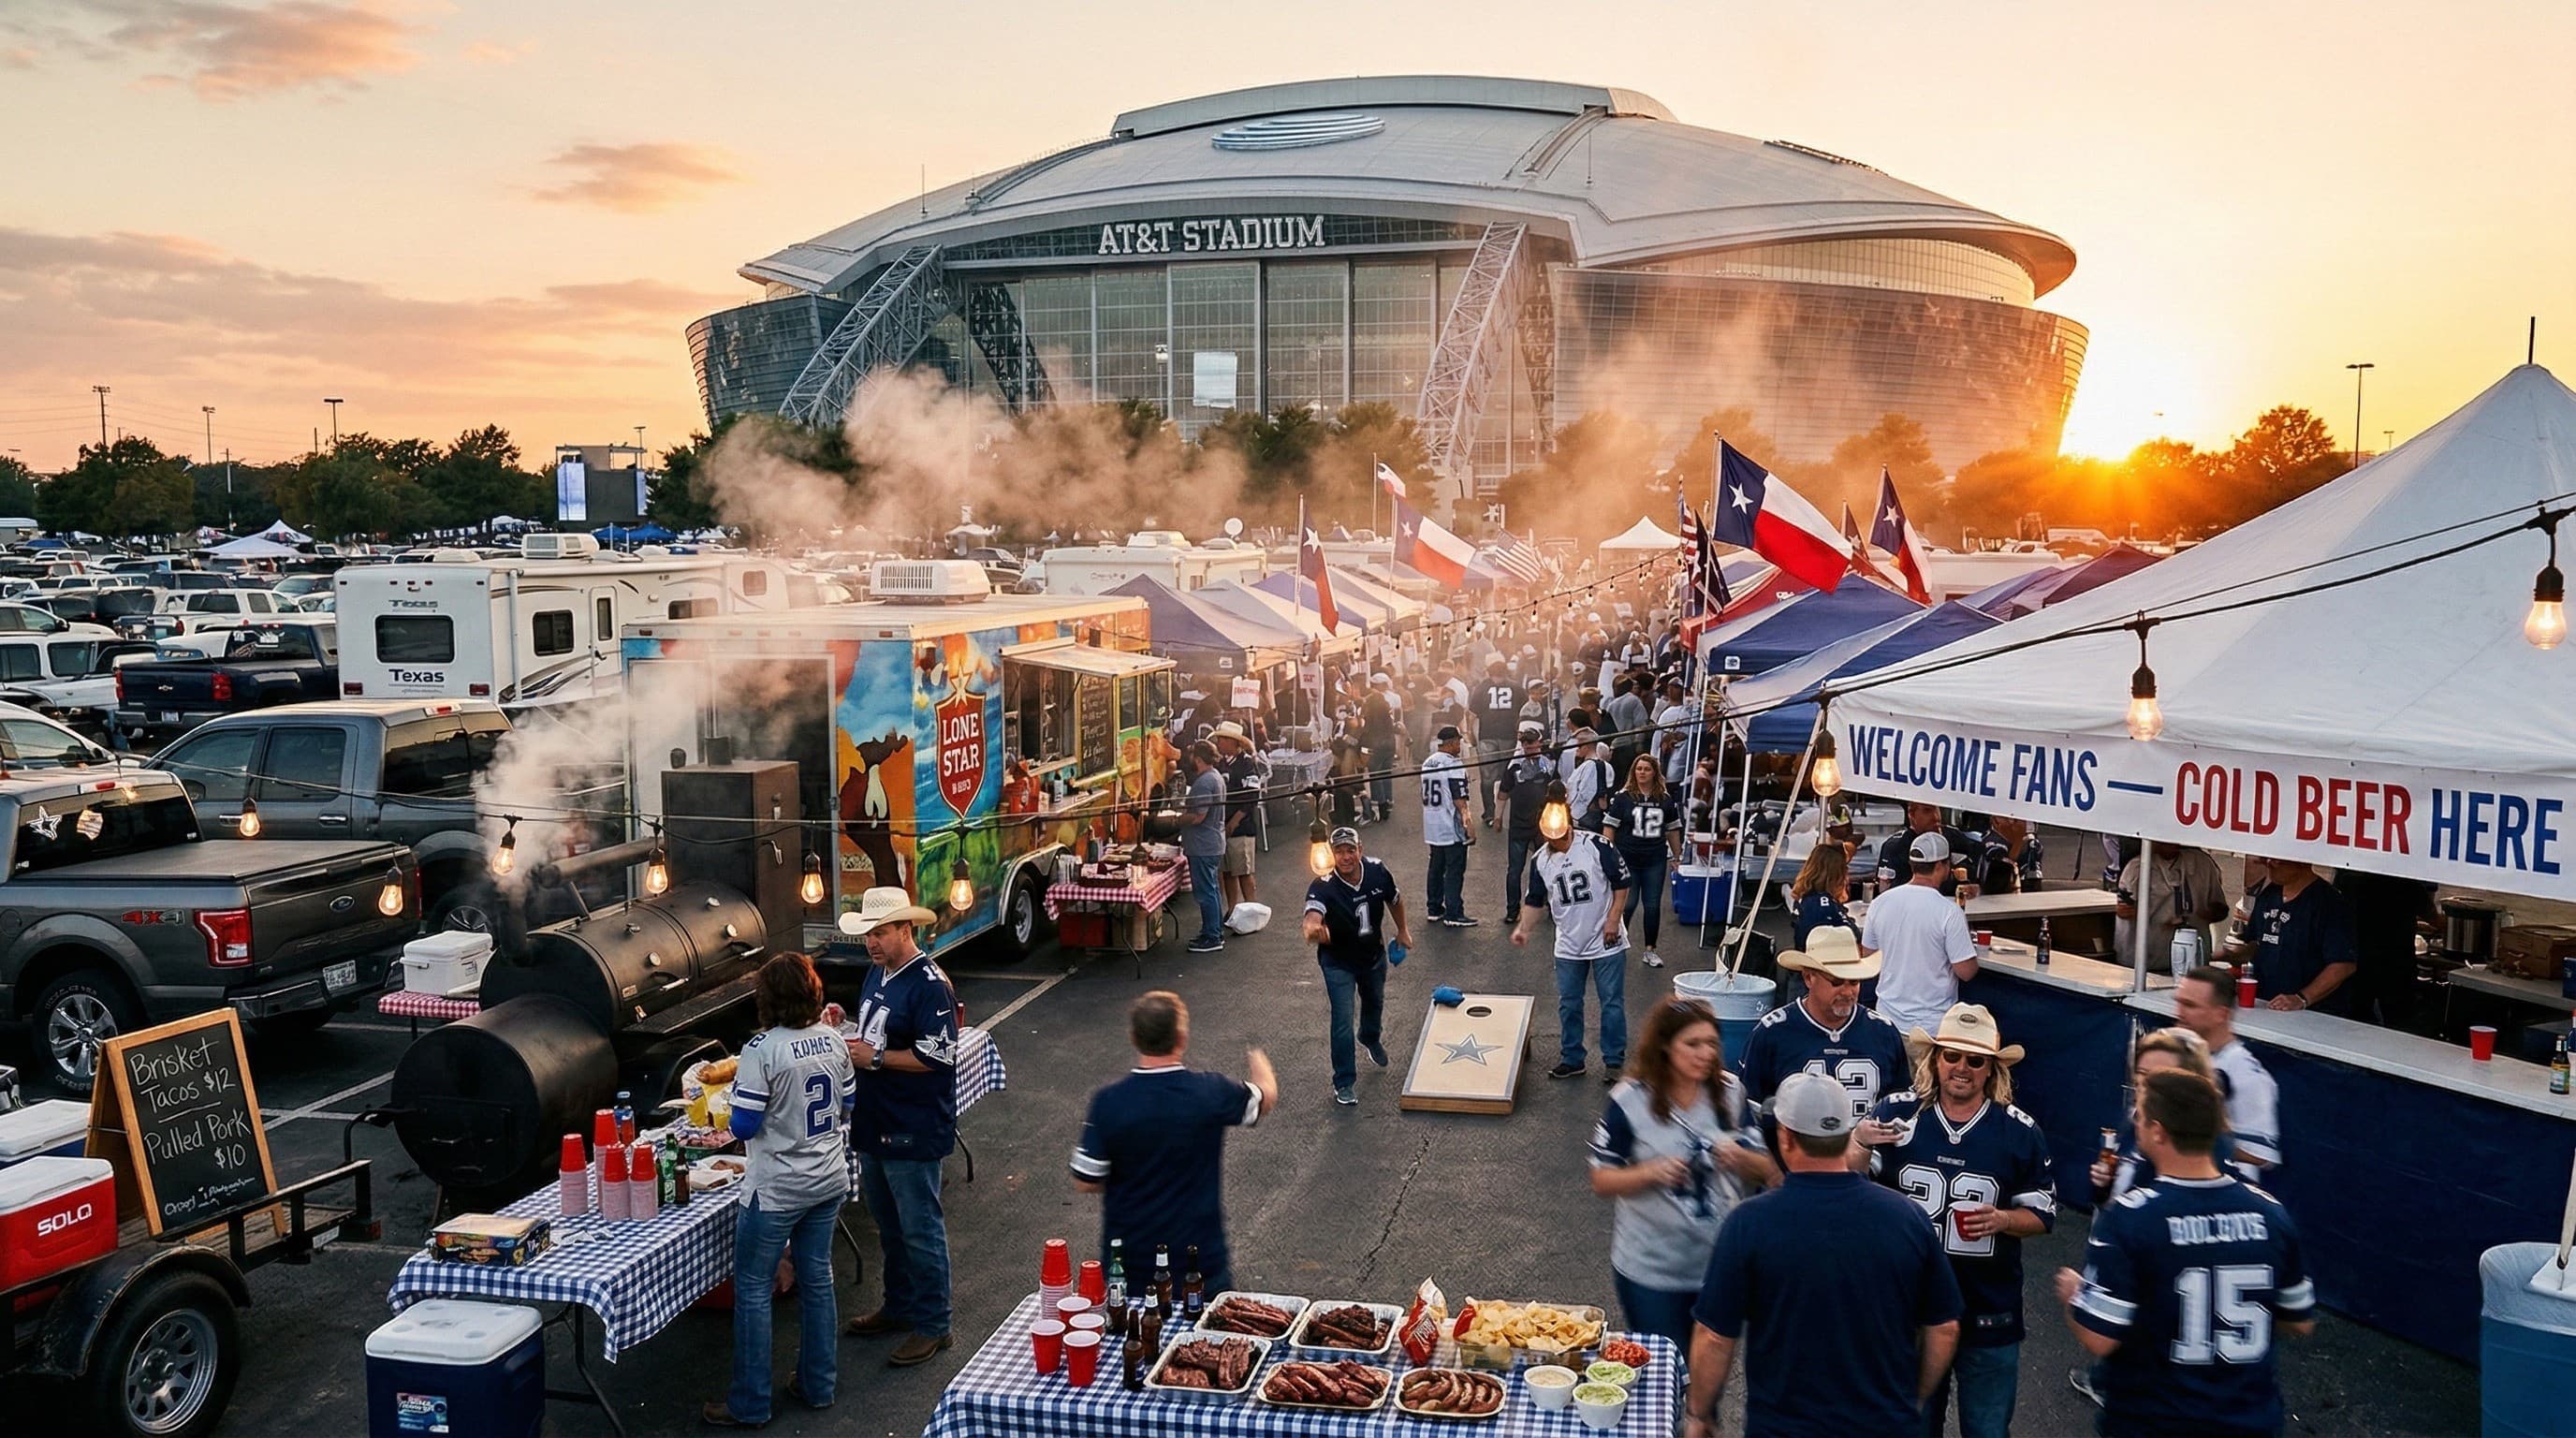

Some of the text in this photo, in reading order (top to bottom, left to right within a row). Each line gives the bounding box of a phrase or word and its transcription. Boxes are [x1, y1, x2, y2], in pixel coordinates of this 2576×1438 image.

[1098, 215, 1325, 255] AT&T STADIUM
[388, 668, 445, 682] Texas
[1488, 686, 1513, 709] 12
[943, 712, 979, 745] LONE
[944, 743, 980, 777] STAR
[1849, 724, 2001, 797] WELCOME
[2009, 743, 2098, 812] FANS
[2174, 761, 2279, 836] COLD
[2295, 774, 2411, 855] BEER
[2429, 787, 2564, 875] HERE
[1632, 806, 1663, 838] 12
[1553, 870, 1593, 906] 12
[1355, 902, 1373, 936] 1
[130, 1037, 219, 1086] Brisket
[140, 1067, 236, 1113] Tacos $12
[804, 1071, 834, 1139] 2
[144, 1108, 251, 1165] Pulled Pork
[214, 1144, 246, 1169] $10
[37, 1203, 92, 1237] SOLO
[2169, 1265, 2274, 1365] 15
